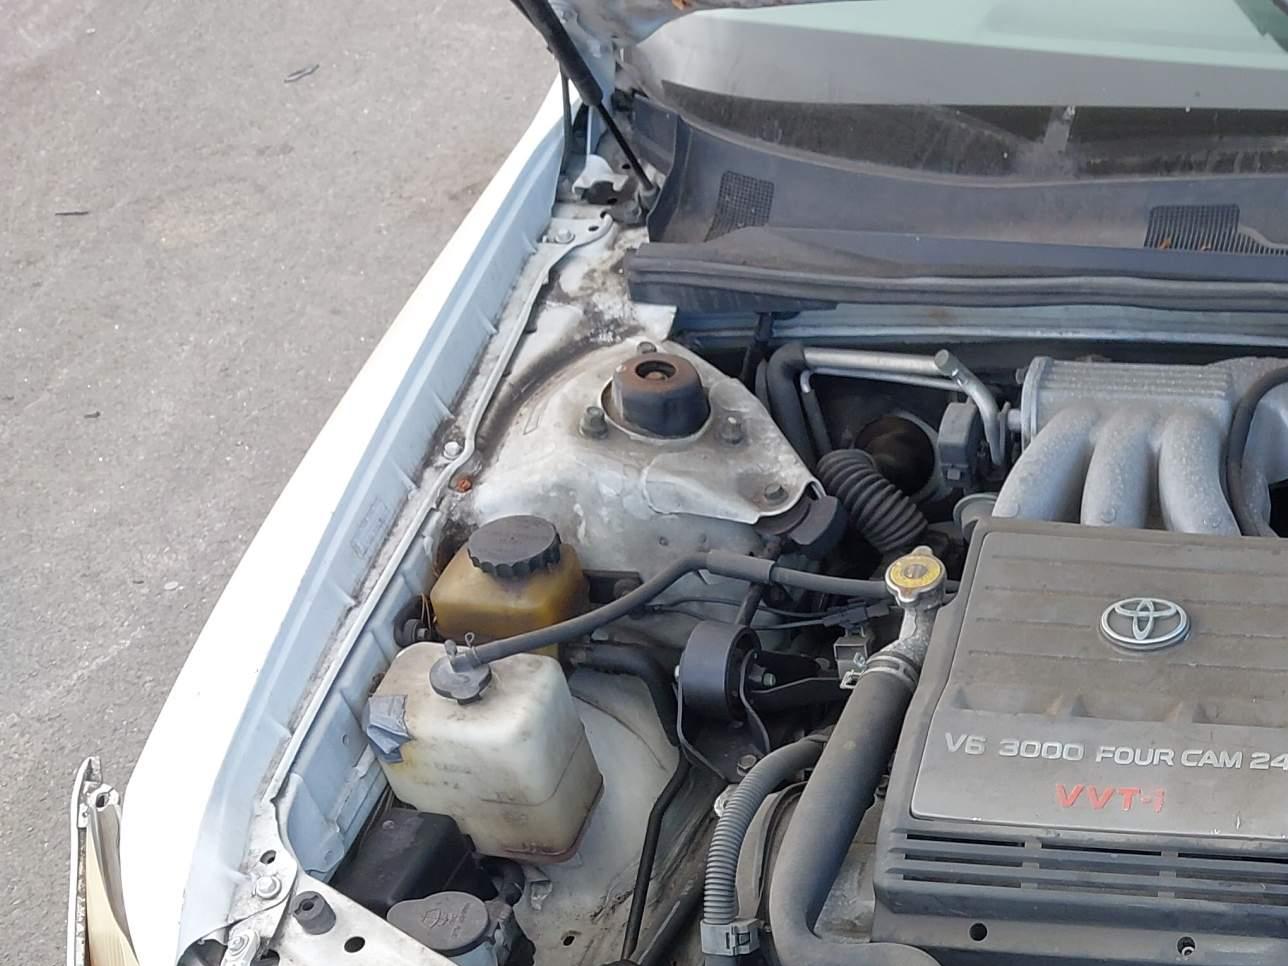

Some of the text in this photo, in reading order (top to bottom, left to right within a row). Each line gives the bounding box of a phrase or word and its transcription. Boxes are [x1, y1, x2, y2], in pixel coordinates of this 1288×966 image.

[945, 733, 986, 754] V6
[998, 738, 1086, 761] 3000
[1095, 746, 1175, 767] FOUR
[1180, 749, 1243, 769] CAM
